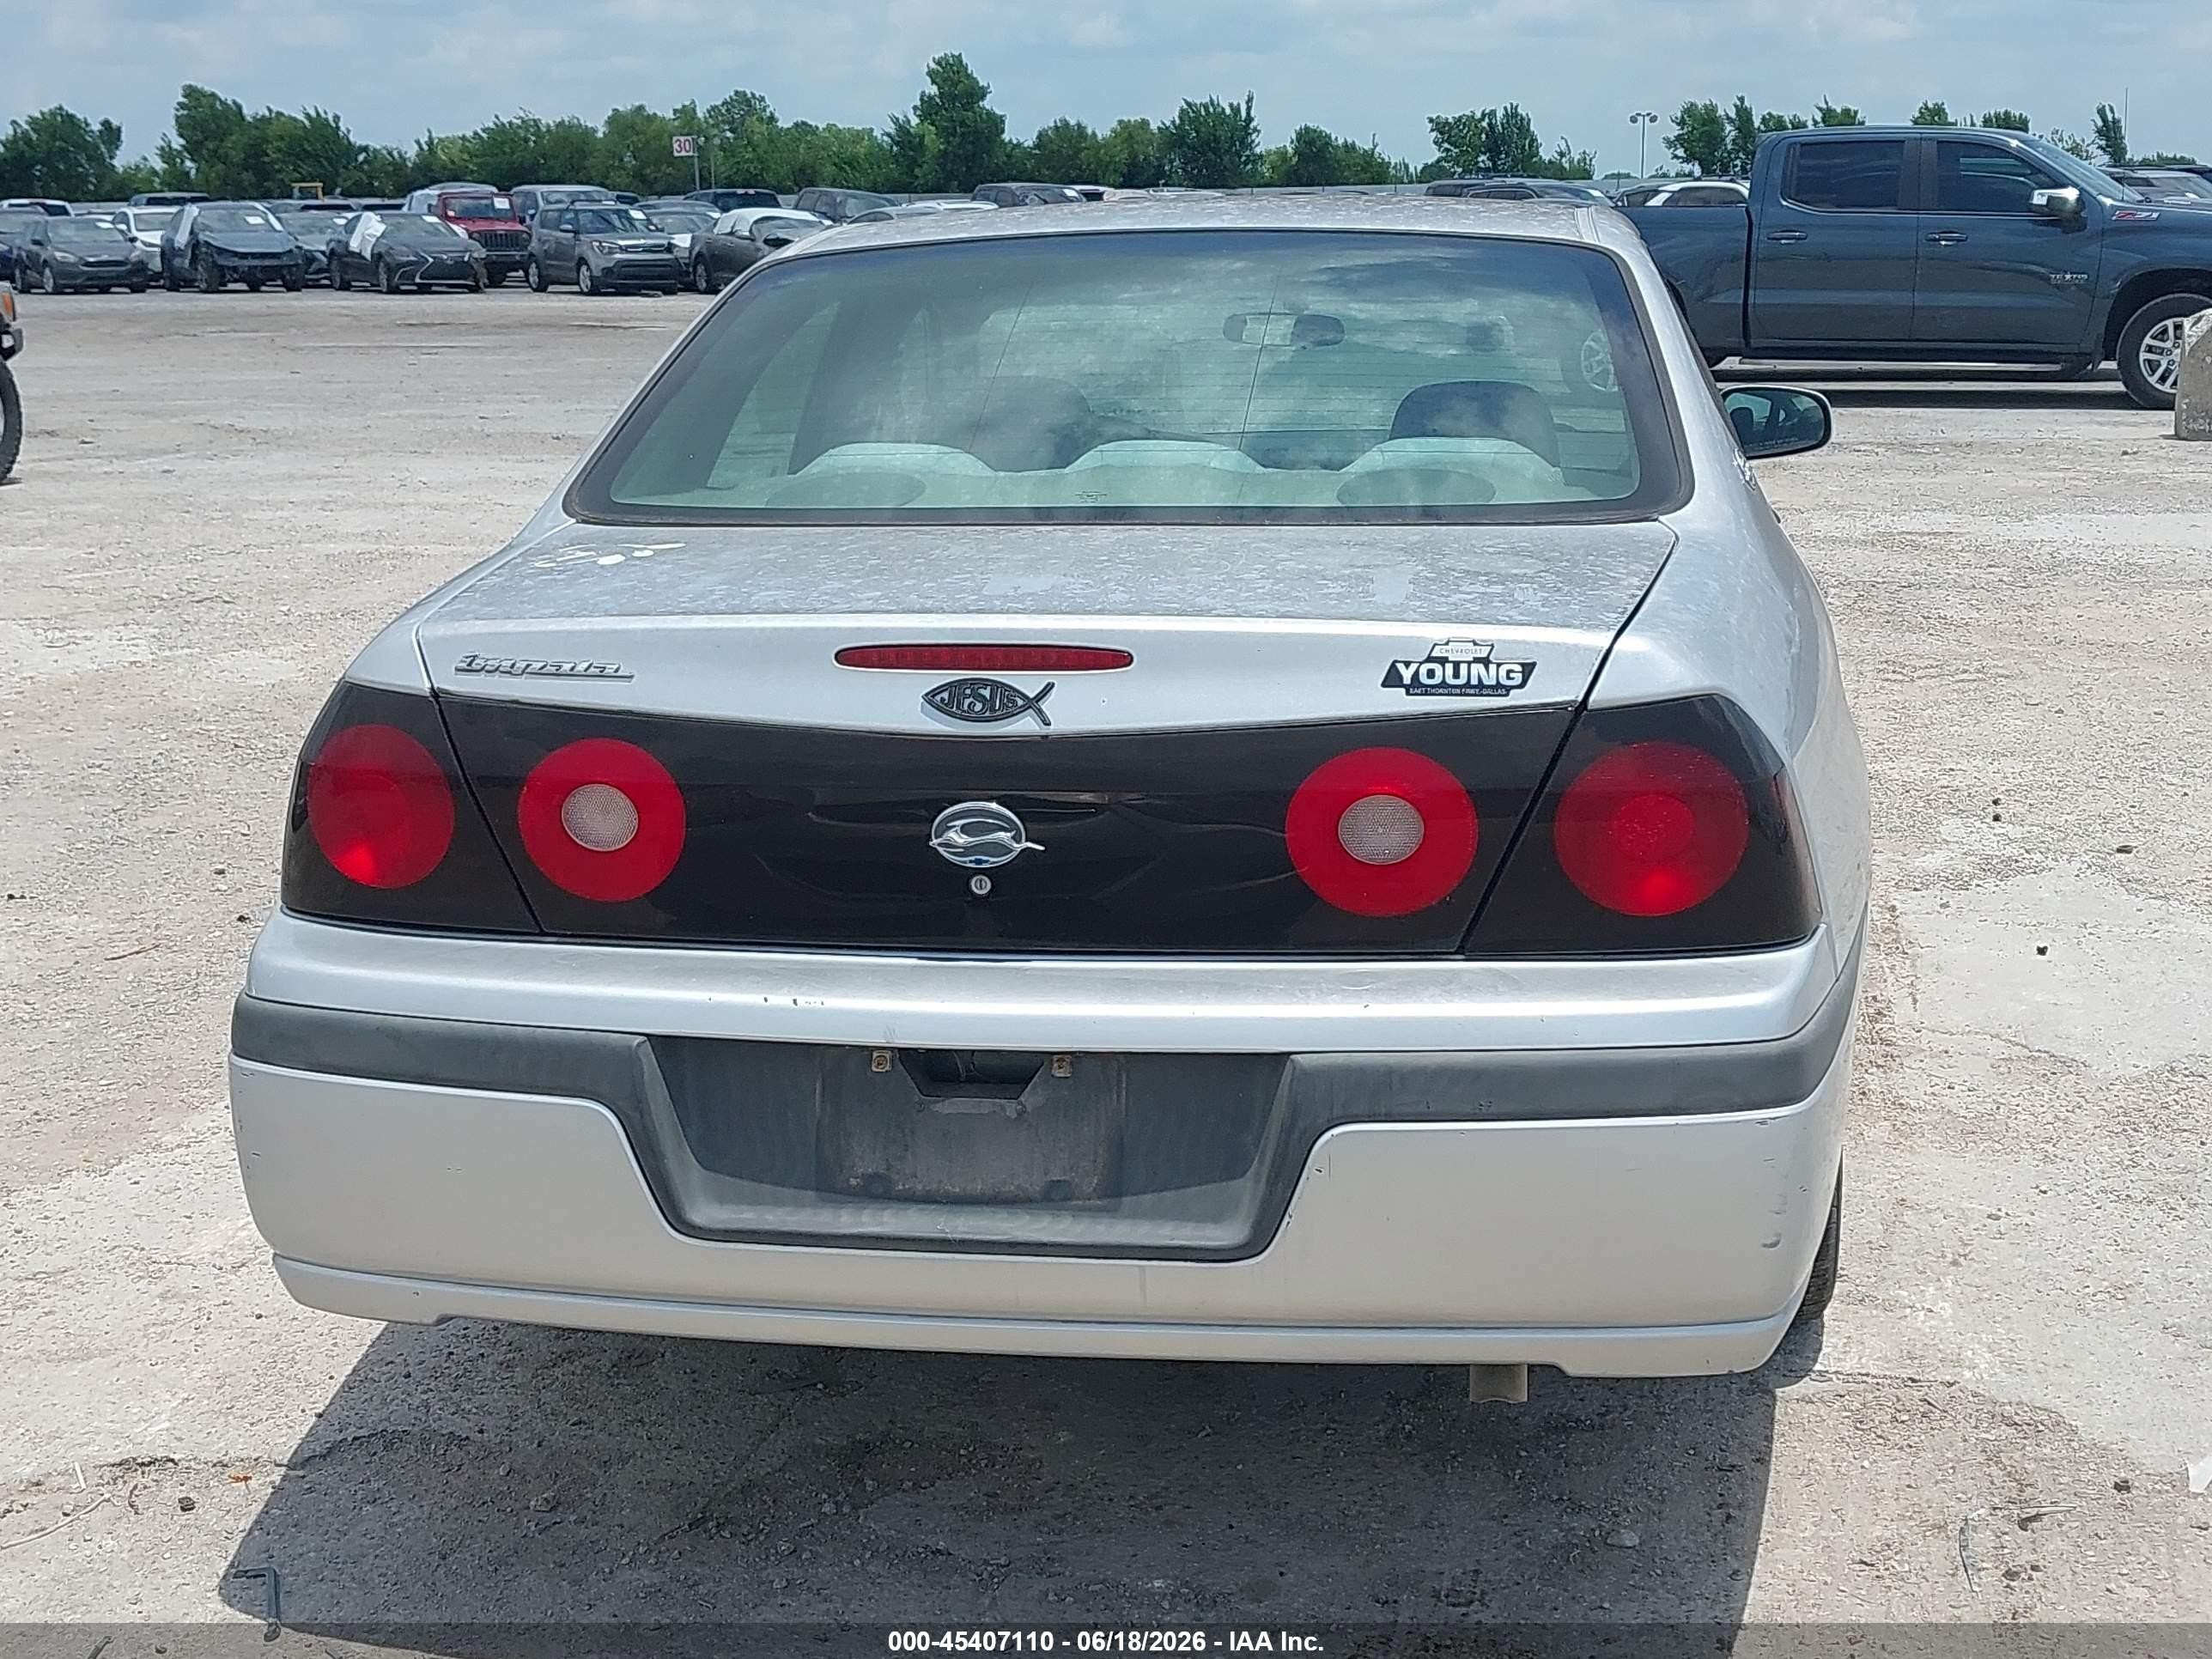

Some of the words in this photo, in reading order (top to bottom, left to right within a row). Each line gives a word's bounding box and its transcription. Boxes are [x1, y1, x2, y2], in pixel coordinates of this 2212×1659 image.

[675, 138, 691, 153] 30
[2112, 210, 2160, 221] Z71
[454, 652, 634, 679] Impala
[1395, 662, 1523, 686] YOUNG
[939, 683, 1018, 715] JESUS
